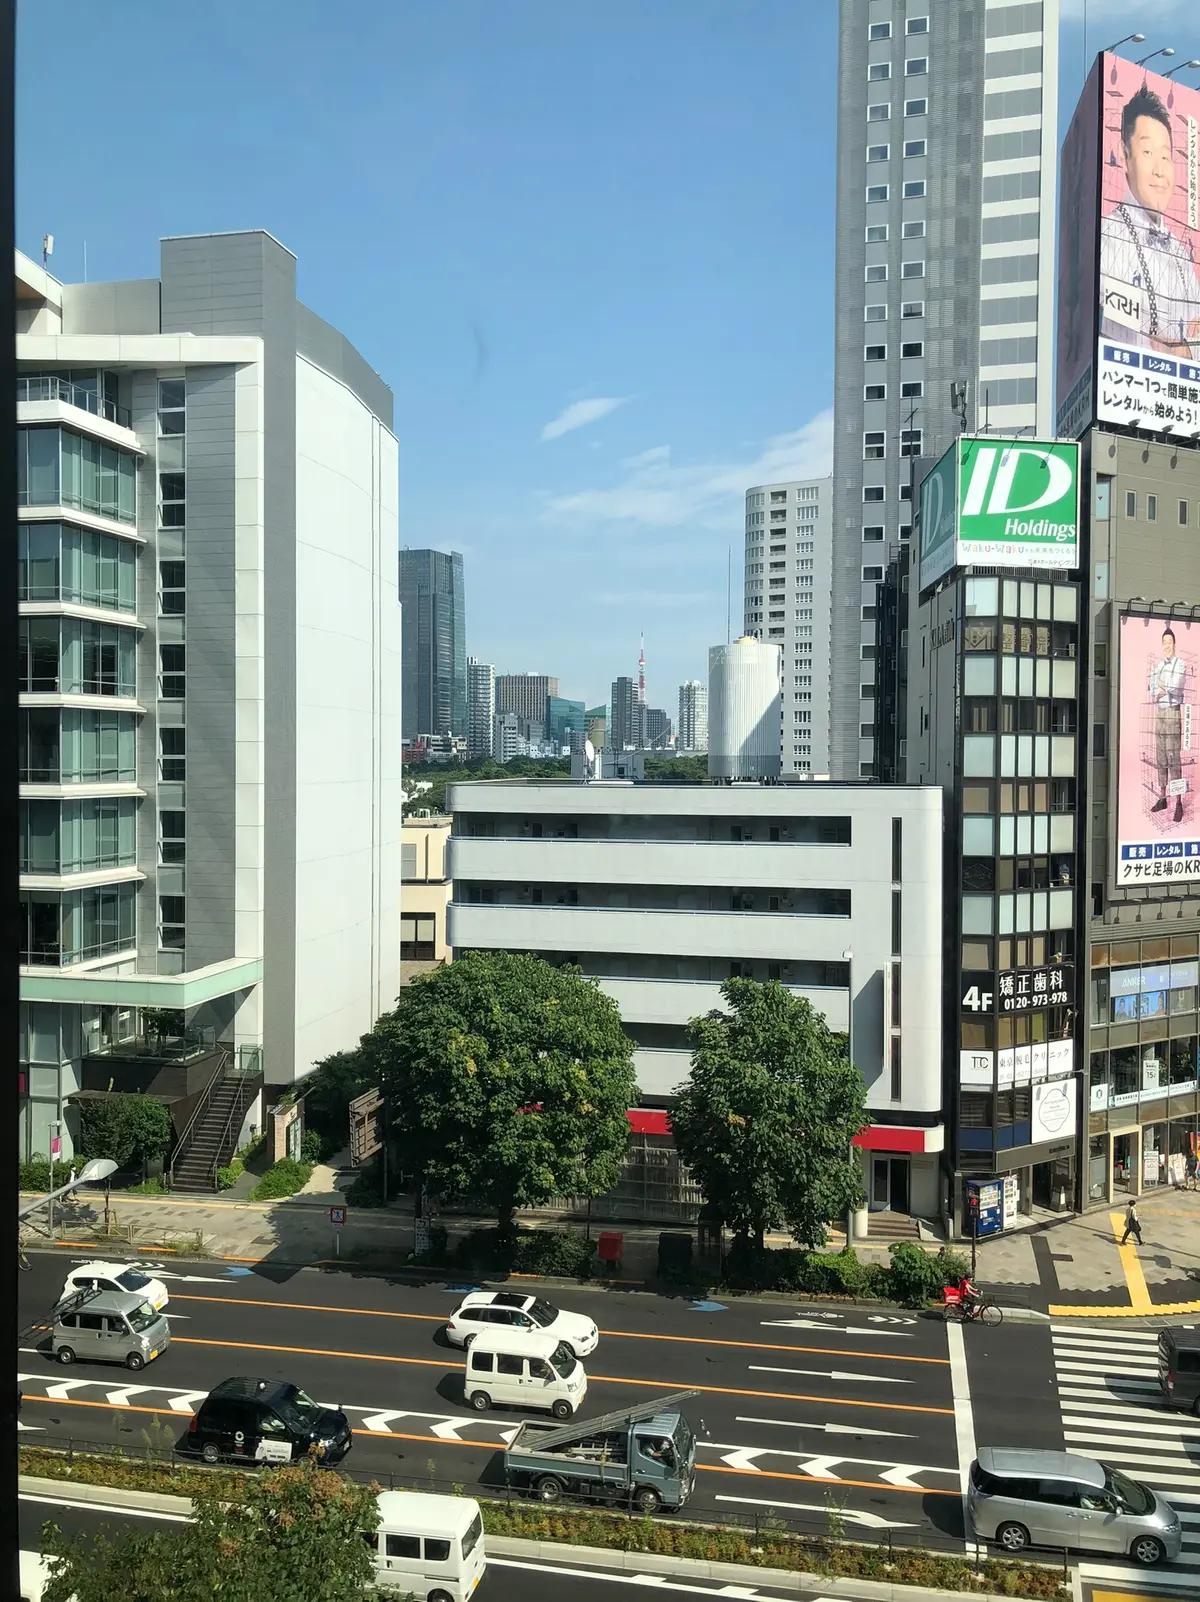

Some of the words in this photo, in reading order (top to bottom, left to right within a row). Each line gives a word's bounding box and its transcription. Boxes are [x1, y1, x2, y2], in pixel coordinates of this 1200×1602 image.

[1105, 288, 1140, 320] KRH
[1113, 350, 1131, 364] 販売
[1148, 358, 1172, 373] レンタル
[1102, 370, 1200, 405] ハンマー1つで簡単施
[961, 447, 1073, 516] ID
[1004, 518, 1076, 542] Holdings
[1129, 846, 1147, 858] 販売
[1156, 845, 1181, 856] レンタル
[999, 970, 1063, 997] 矯正歯科
[1121, 976, 1146, 988] ANKER
[962, 985, 993, 1011] 4F
[1004, 991, 1068, 1011] 0120-973-978
[999, 1047, 1070, 1068] 東京脱毛クリニック
